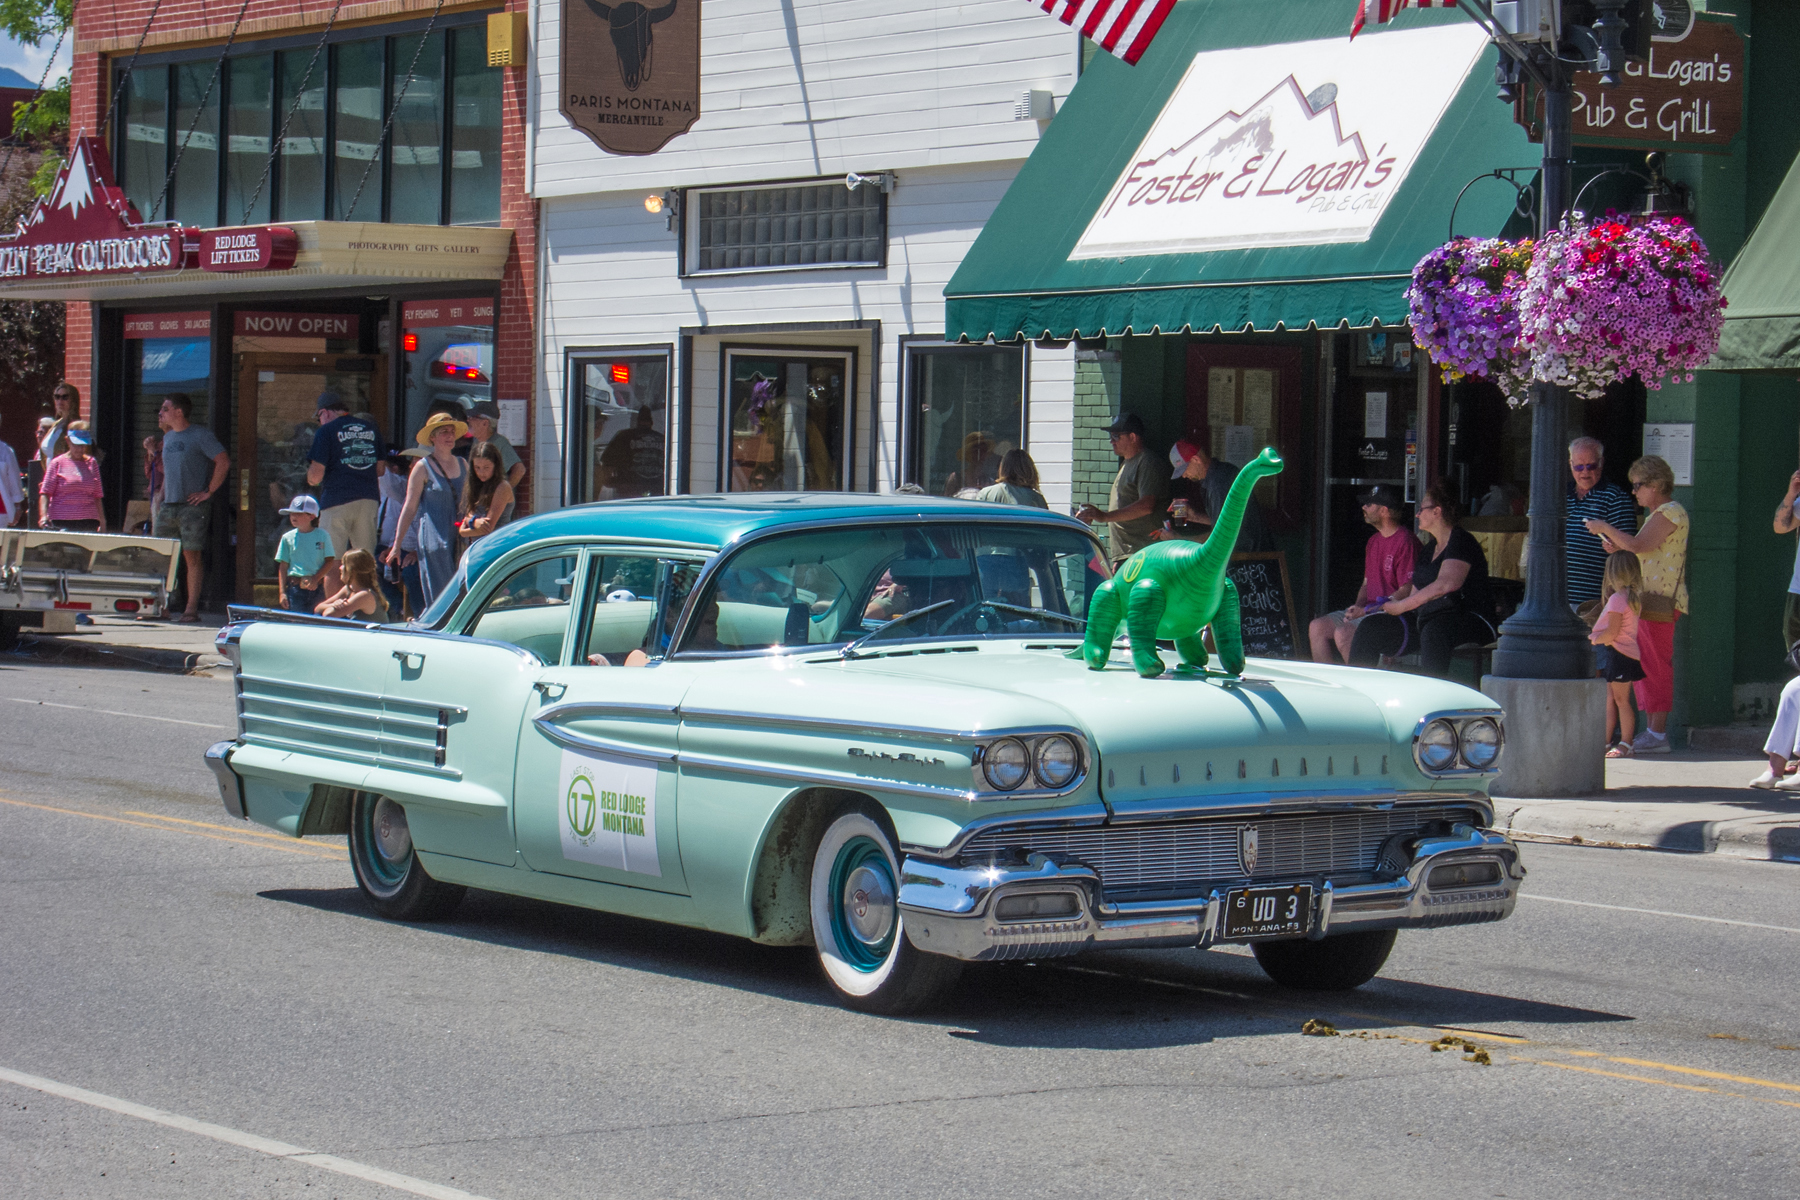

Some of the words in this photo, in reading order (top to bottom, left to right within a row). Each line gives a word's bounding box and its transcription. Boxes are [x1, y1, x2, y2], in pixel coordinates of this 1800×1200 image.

[1648, 47, 1731, 87] Logan's
[570, 94, 612, 109] PARIS
[617, 97, 692, 112] MONTANA
[598, 113, 664, 126] MERCANTILE
[1625, 98, 1647, 130] &
[1656, 98, 1716, 141] Grill
[1102, 156, 1222, 219] Foster
[1223, 154, 1264, 200] &
[1256, 143, 1397, 204] Logan's
[1307, 195, 1334, 213] Pub
[1336, 196, 1351, 212] &
[1351, 192, 1385, 214] Grill
[215, 235, 231, 250] RED
[231, 234, 257, 249] LODGE
[348, 241, 409, 251] PHOTOGRAPHY
[415, 243, 439, 252] GIFTS
[443, 245, 481, 254] GALLERY
[31, 242, 76, 274] PEAK
[76, 234, 171, 271] OUTDOORS
[211, 250, 228, 265] LIFT
[229, 248, 260, 263] TICKETS
[405, 310, 414, 319] FLY
[415, 309, 439, 319] FISHING
[450, 307, 463, 318] YETI
[135, 321, 154, 331] TICKETS
[160, 320, 179, 330] GLOVES
[245, 316, 293, 332] NOW
[298, 318, 348, 333] OPEN
[571, 792, 595, 833] 17
[601, 790, 618, 812] RED
[619, 793, 646, 816] LODGE
[602, 812, 645, 837] MONTANA
[1236, 896, 1246, 908] 6
[1252, 896, 1276, 922] UD
[1285, 895, 1298, 919] 3
